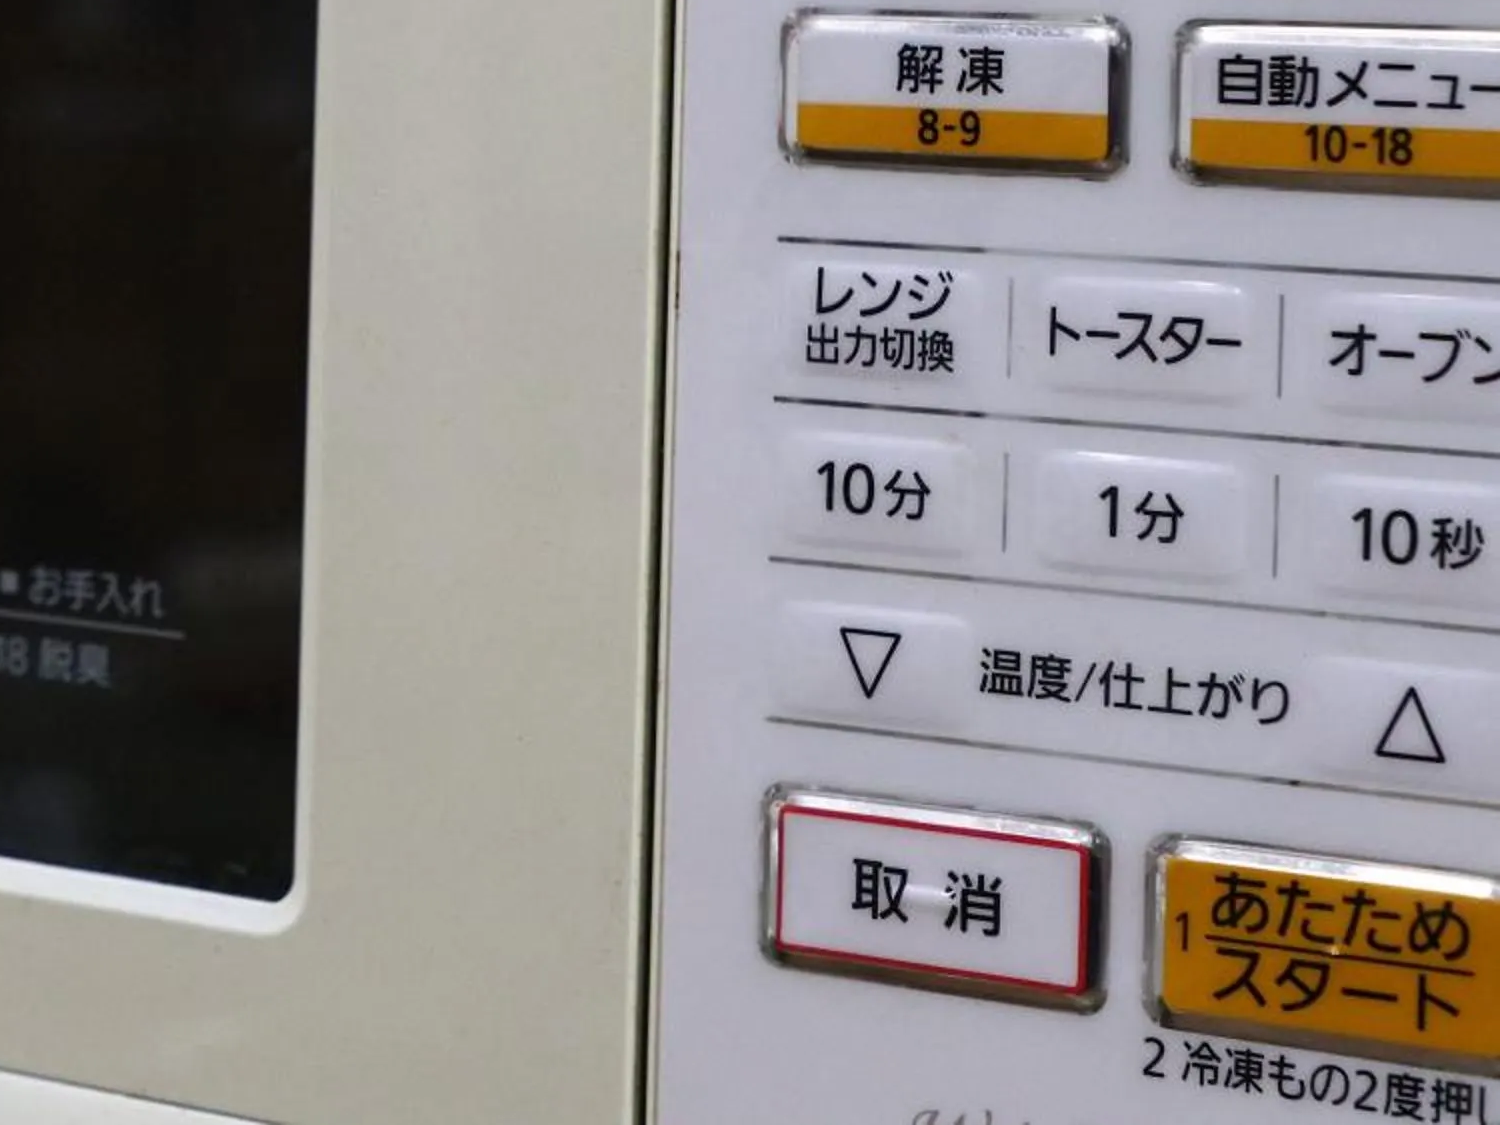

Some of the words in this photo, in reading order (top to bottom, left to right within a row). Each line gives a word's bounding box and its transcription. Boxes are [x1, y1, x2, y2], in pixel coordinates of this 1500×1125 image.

[896, 42, 1006, 97] 解凍
[1217, 53, 1500, 111] 自動メニュー
[917, 108, 982, 148] 8-9
[1303, 124, 1414, 167] 10-18
[815, 266, 955, 320] レンジ
[805, 322, 955, 374] 出力切換
[1048, 305, 1243, 365] トースター
[1328, 322, 1500, 385] オーブン
[816, 460, 932, 521] 10分
[1098, 484, 1186, 544] 1分
[1351, 506, 1486, 571] 10秒
[27, 563, 167, 619] お手入れ
[978, 646, 1292, 726] 温度/仕上がり
[851, 858, 1003, 938] 取消
[1211, 872, 1471, 961] あたため
[1174, 911, 1191, 953] 1
[1213, 947, 1461, 1032] スタート
[1142, 1037, 1167, 1080] 2
